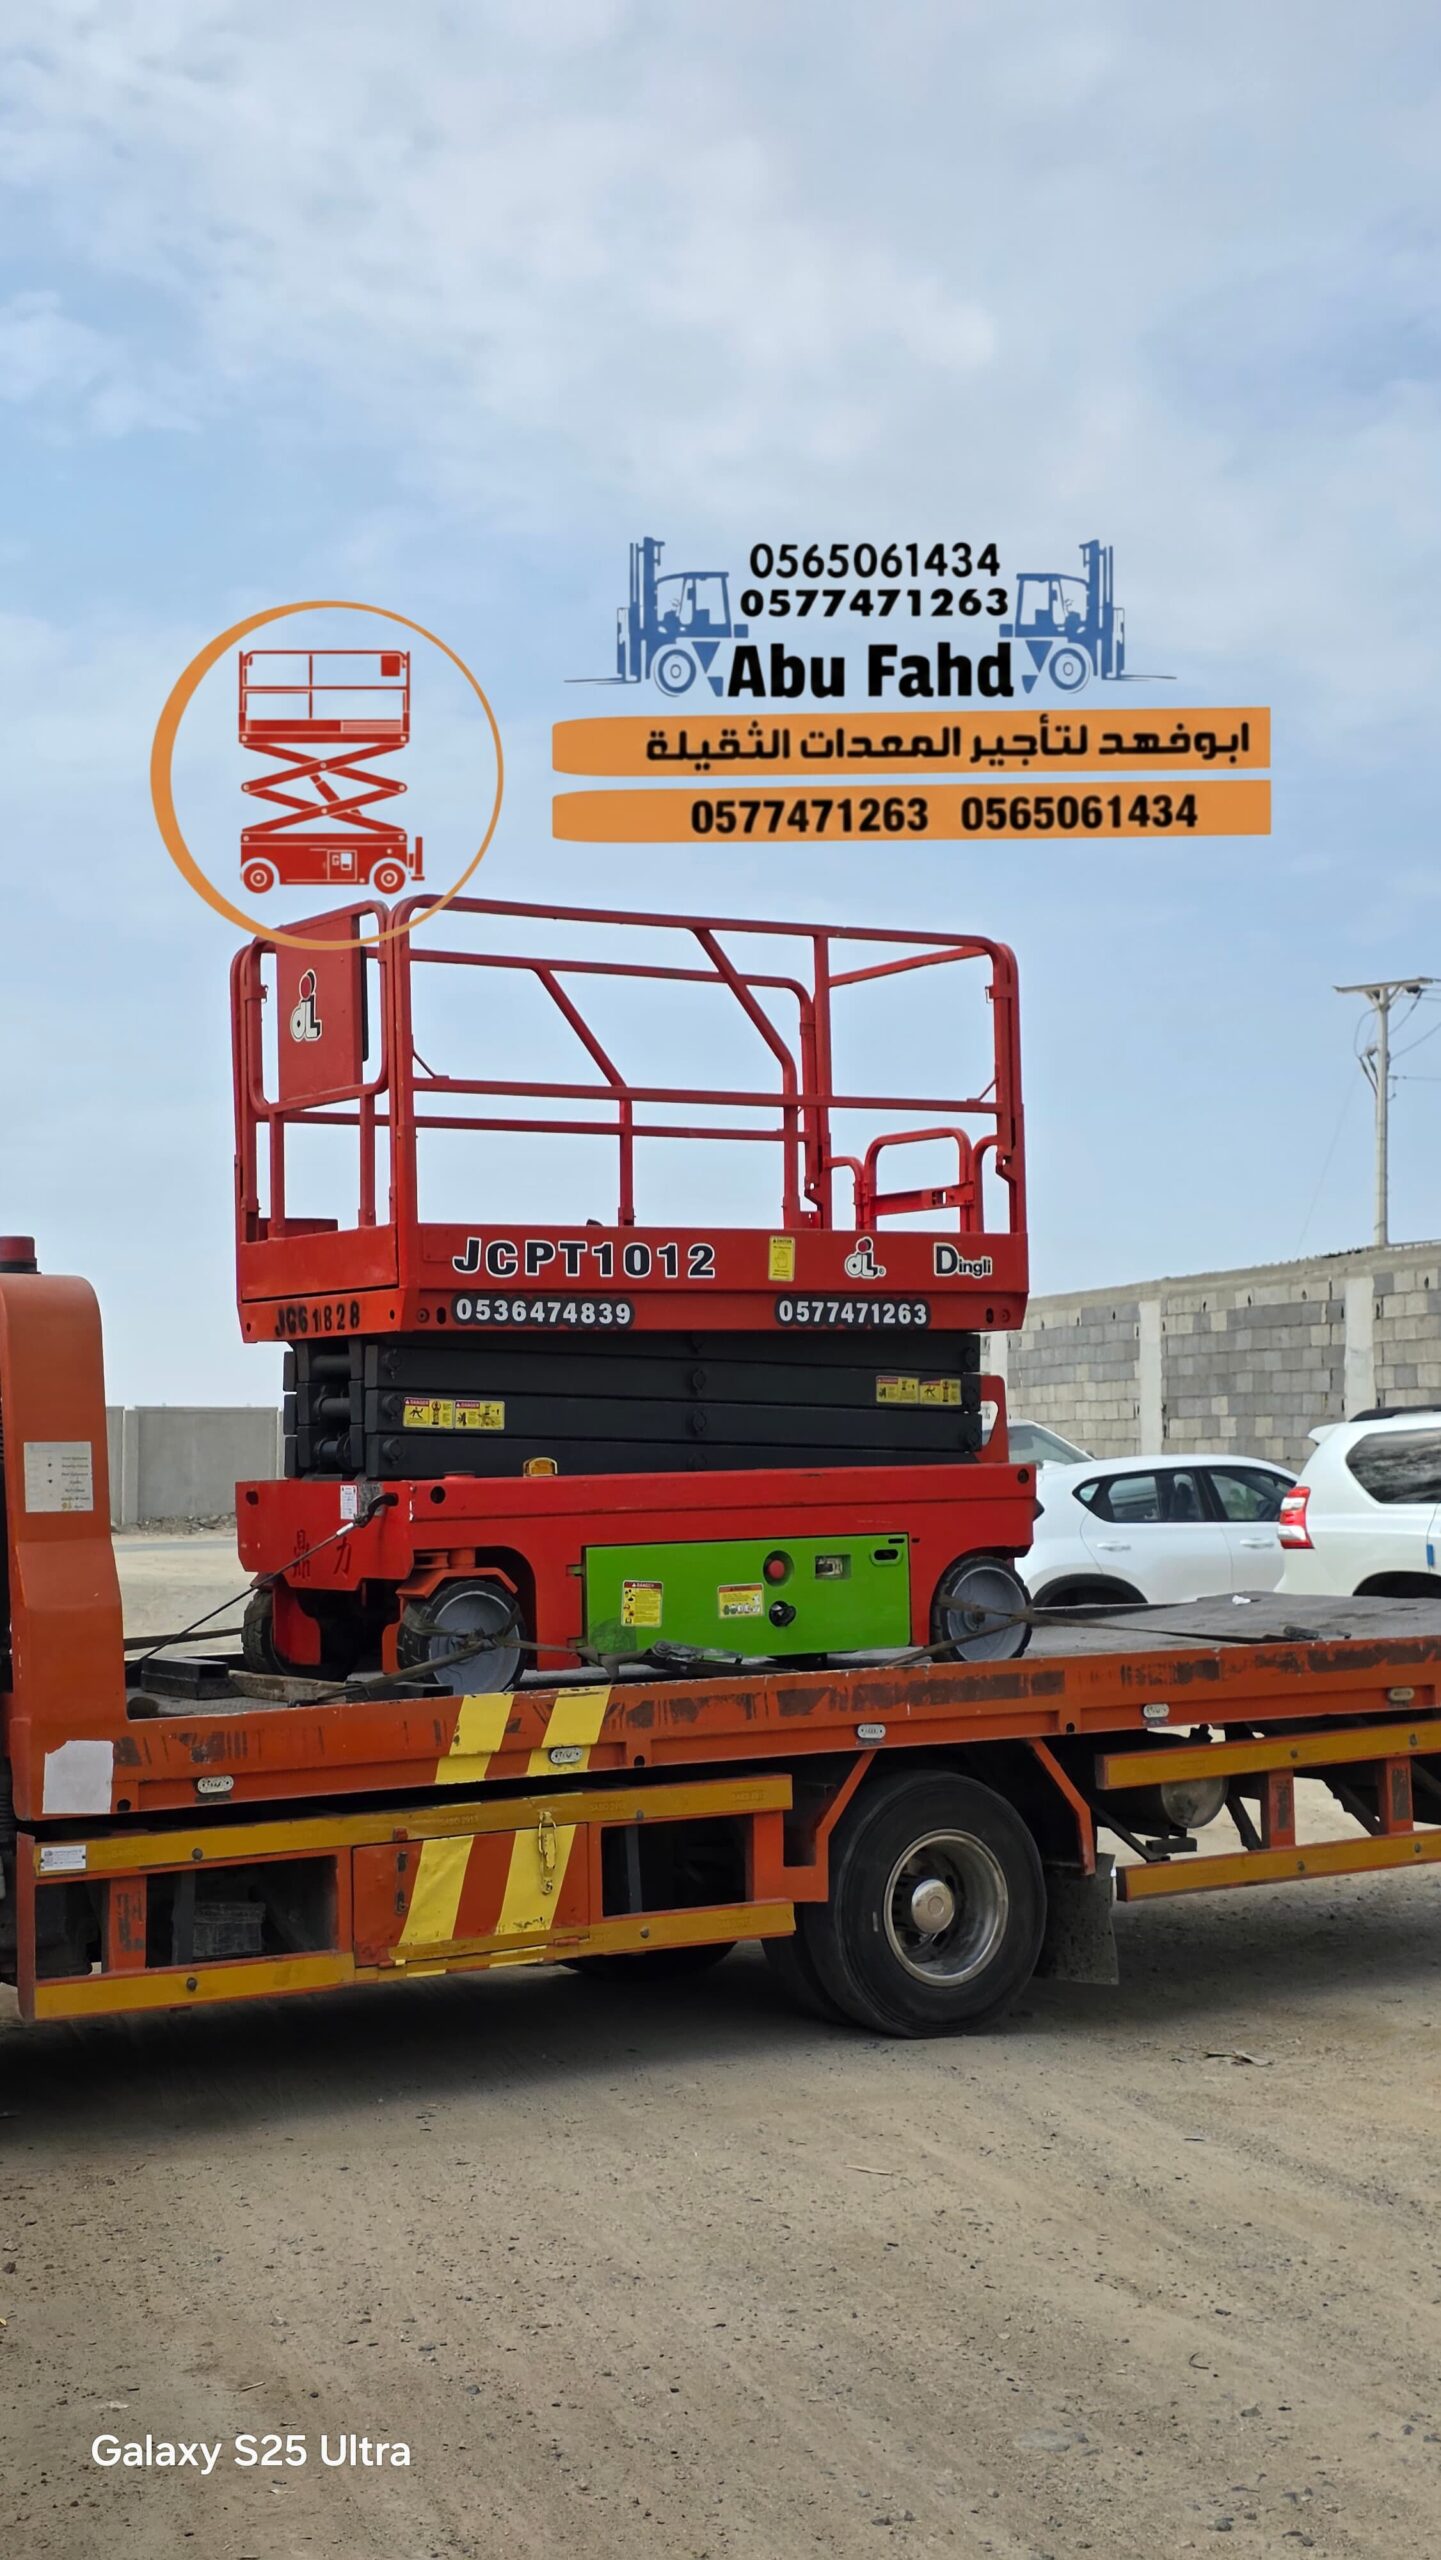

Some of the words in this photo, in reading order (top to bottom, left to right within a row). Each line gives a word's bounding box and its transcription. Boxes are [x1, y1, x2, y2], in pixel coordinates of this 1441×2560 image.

[452, 1236, 716, 1279] JCPT1012
[933, 1242, 993, 1279] Dingli
[456, 1299, 631, 1324] 0536474839
[779, 1300, 927, 1325] 0577471263
